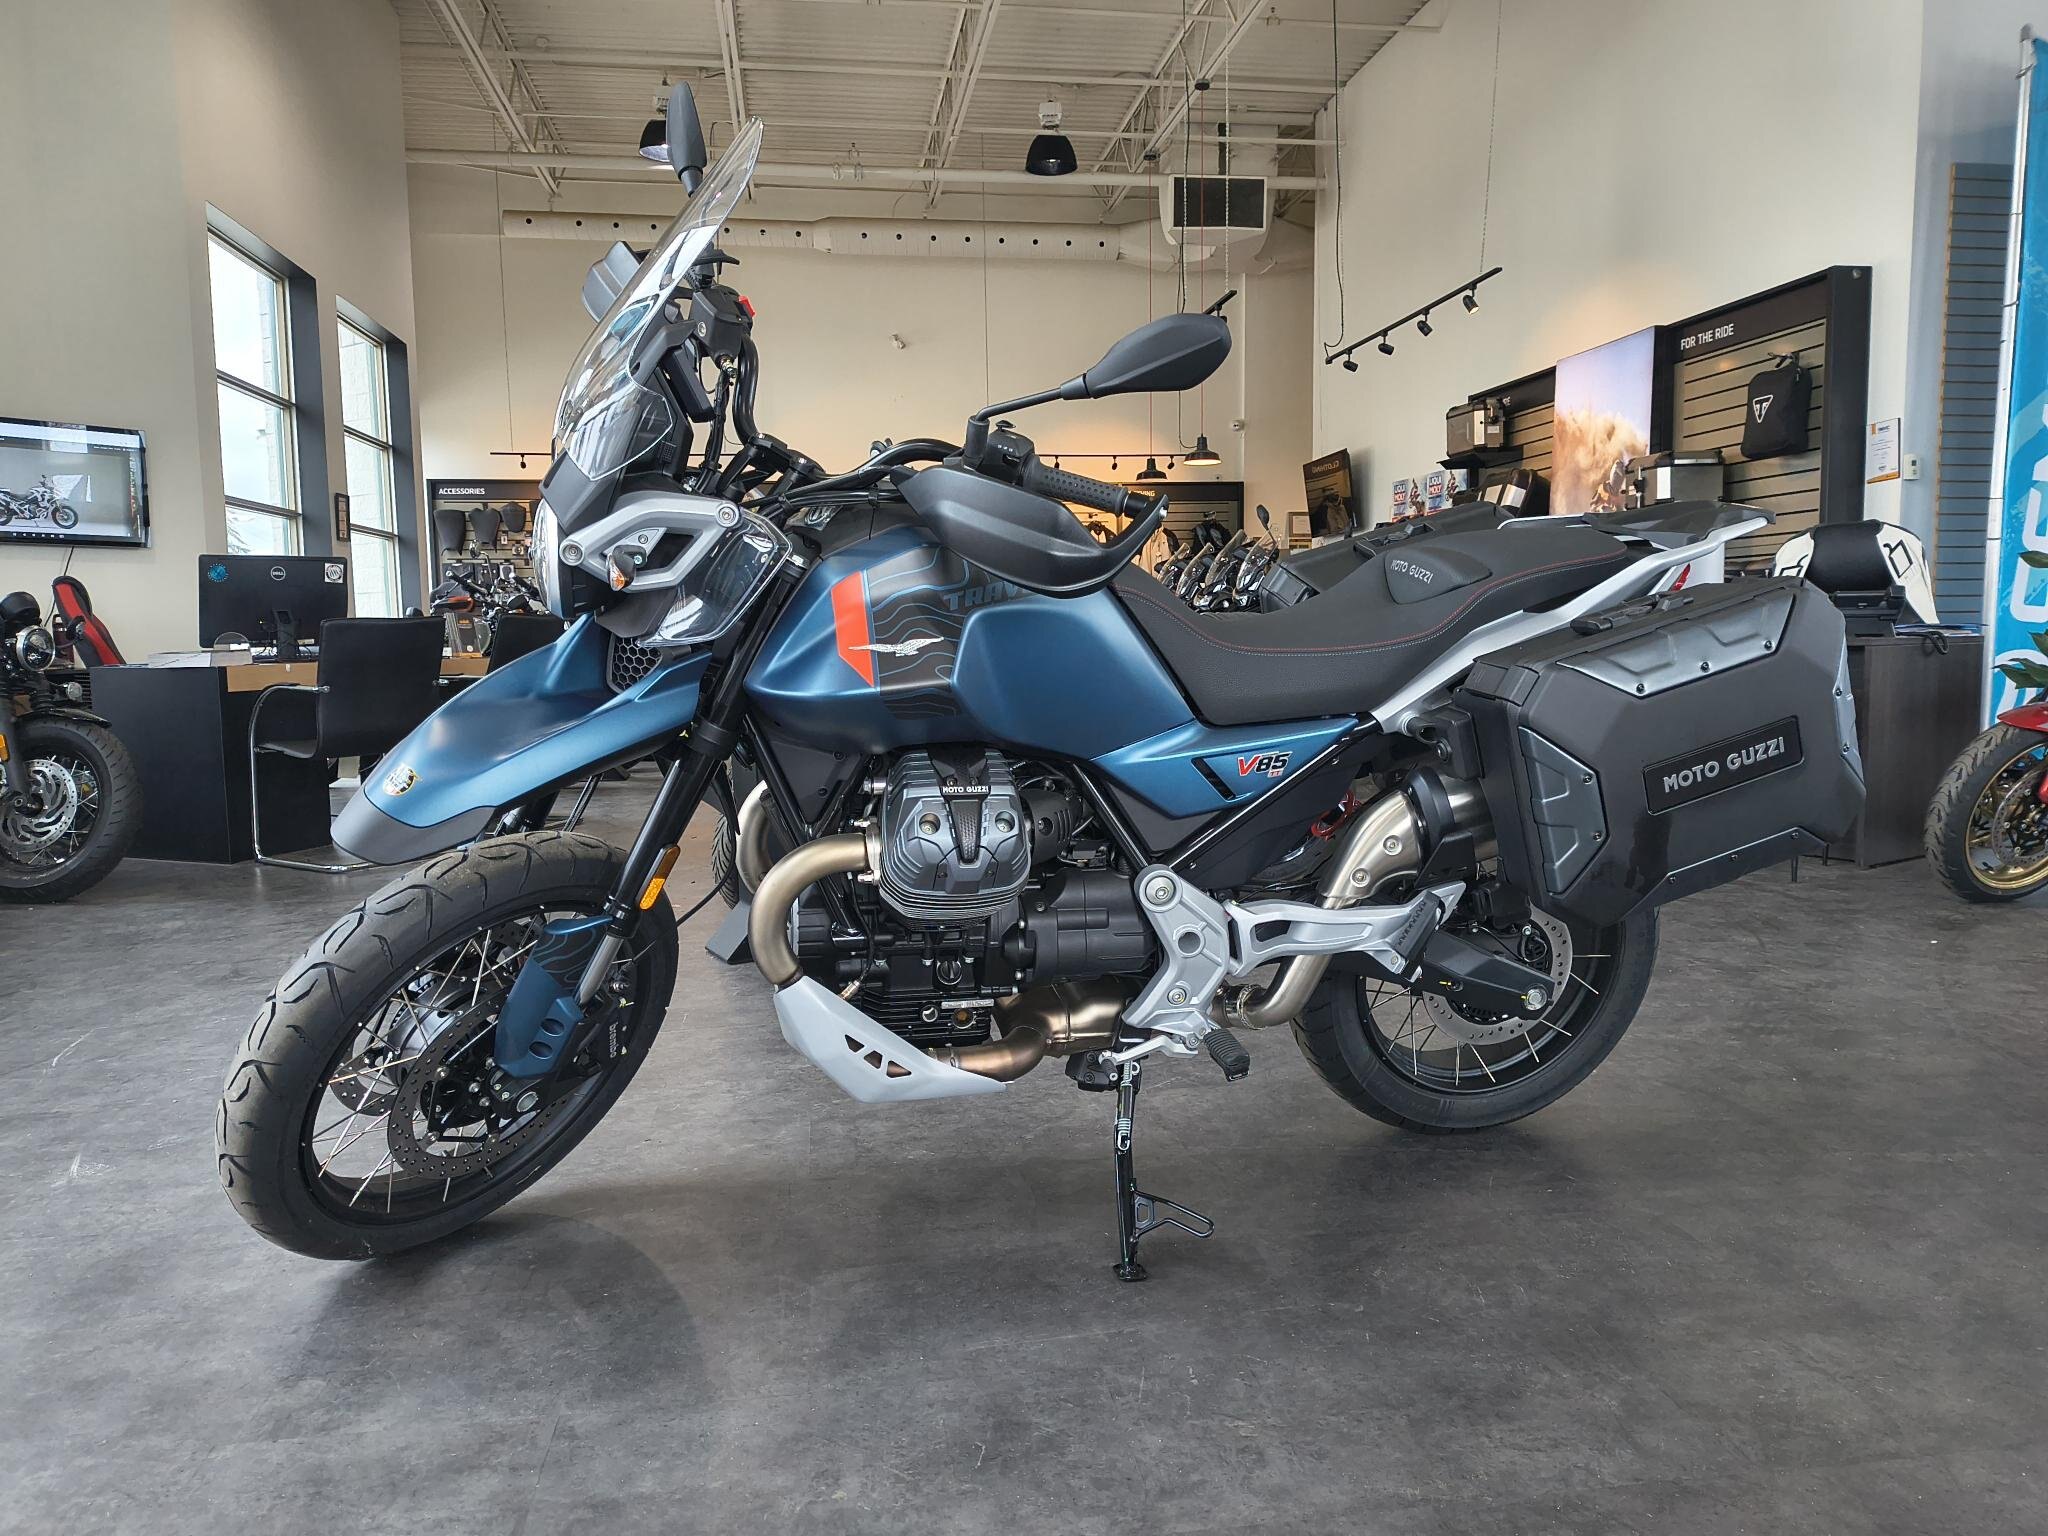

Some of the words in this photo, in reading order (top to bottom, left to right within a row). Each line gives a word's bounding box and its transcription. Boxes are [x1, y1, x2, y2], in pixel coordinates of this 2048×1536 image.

[1680, 336, 1696, 351] FOR
[1697, 330, 1714, 345] THE
[1714, 323, 1735, 340] RIDE
[1391, 559, 1409, 573] MOTO
[1409, 564, 1434, 584] GUZZI
[1238, 751, 1292, 776] V85
[1663, 761, 1720, 793] MOTO
[1726, 736, 1785, 770] GUZZI
[942, 786, 964, 794] MOTO
[966, 785, 989, 793] GUZZI
[609, 1021, 619, 1058] brembo
